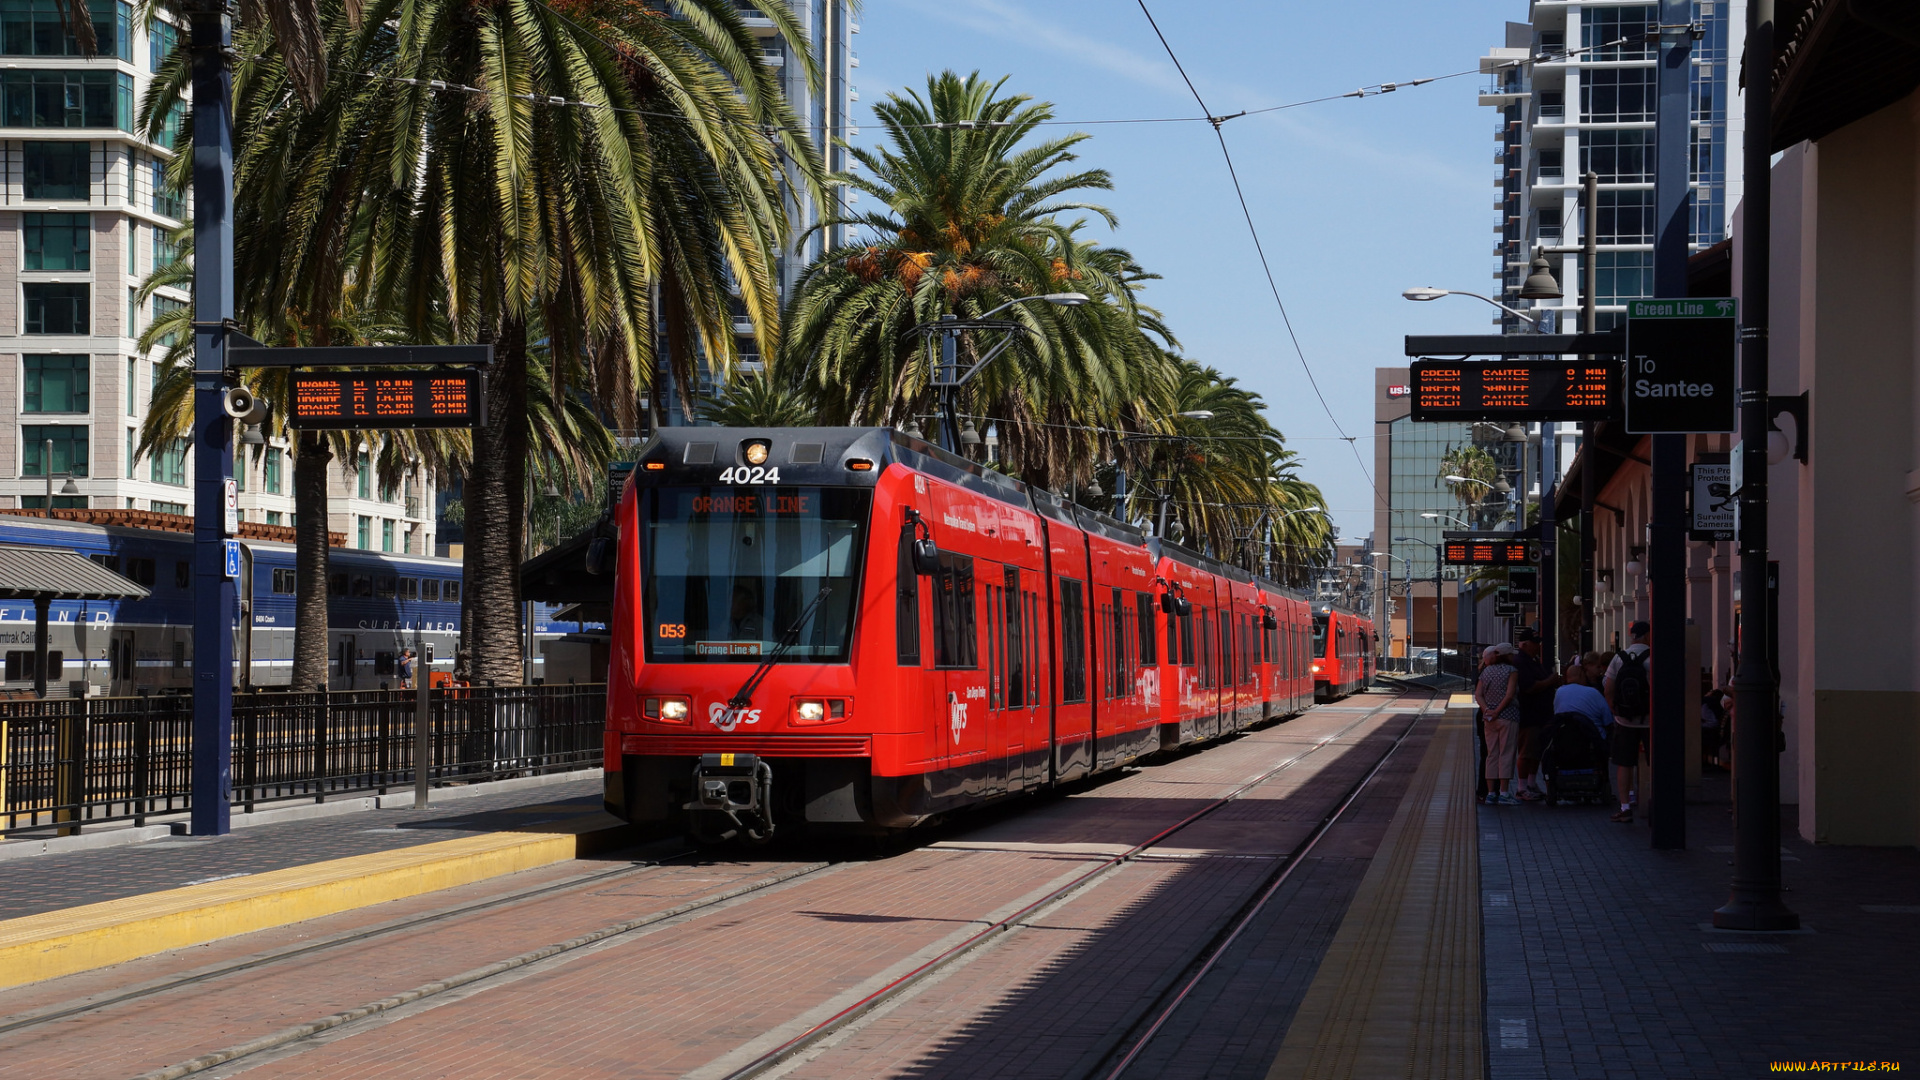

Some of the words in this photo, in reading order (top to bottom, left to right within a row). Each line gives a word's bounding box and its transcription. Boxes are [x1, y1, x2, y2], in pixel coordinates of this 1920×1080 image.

[1635, 302, 1673, 316] Green
[1676, 302, 1704, 315] Line
[1634, 355, 1656, 374] To
[1420, 369, 1461, 382] GREEN
[1482, 369, 1530, 381] SANTEE
[1585, 368, 1606, 380] MIN
[1389, 385, 1411, 395] usb
[1634, 379, 1714, 398] Santee
[297, 404, 342, 416] ORANGE
[354, 404, 370, 415] EL
[376, 403, 414, 415] CAJON
[447, 402, 467, 414] MIN
[719, 466, 780, 485] 4024
[692, 496, 757, 513] ORANGE
[766, 496, 809, 513] LINE
[0, 632, 20, 644] mtrak
[659, 623, 686, 638] 053
[698, 643, 728, 655] Orange
[729, 643, 748, 655] Line
[709, 706, 762, 727] MTS
[951, 698, 968, 733] MTS
